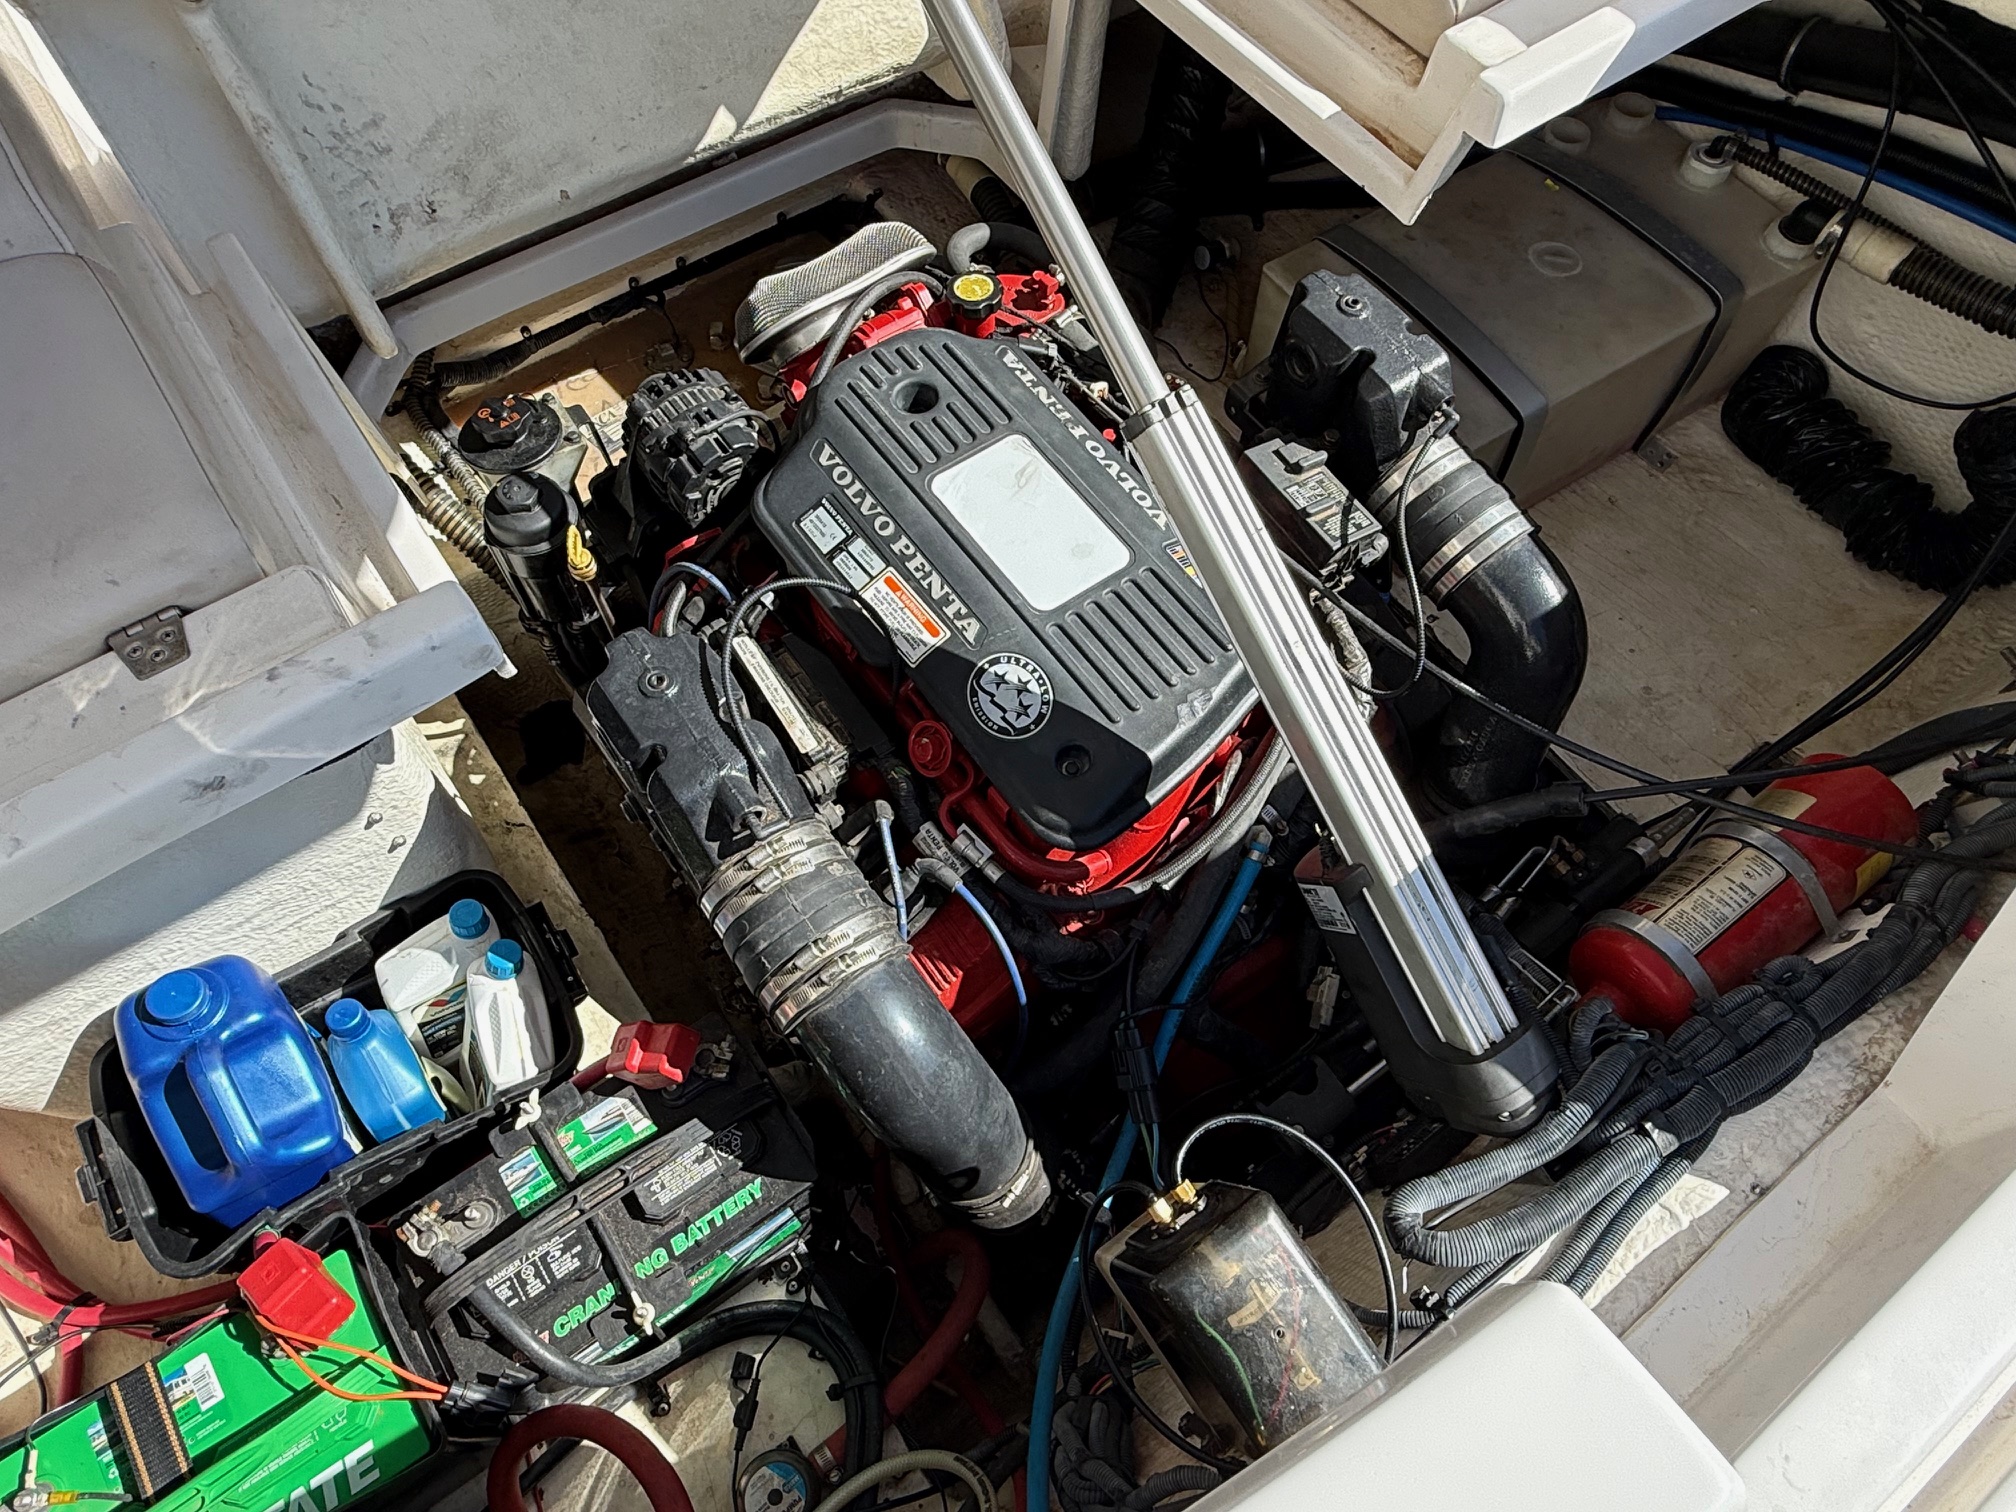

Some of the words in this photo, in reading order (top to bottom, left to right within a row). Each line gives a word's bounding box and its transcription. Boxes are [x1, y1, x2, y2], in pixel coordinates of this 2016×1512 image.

[1002, 350, 1090, 440] PENTA
[1085, 440, 1169, 531] VOLVO
[818, 443, 896, 536] VOLVO
[890, 535, 981, 646] PENTA
[899, 593, 927, 623] WARNING
[972, 697, 999, 730] EMISSION
[924, 827, 942, 850] PENTA
[941, 850, 959, 873] VOLVO
[670, 1176, 765, 1256] BATTERY
[484, 1258, 522, 1287] DANGER
[527, 1234, 560, 1259] POISON
[263, 1439, 384, 1512] ATE
